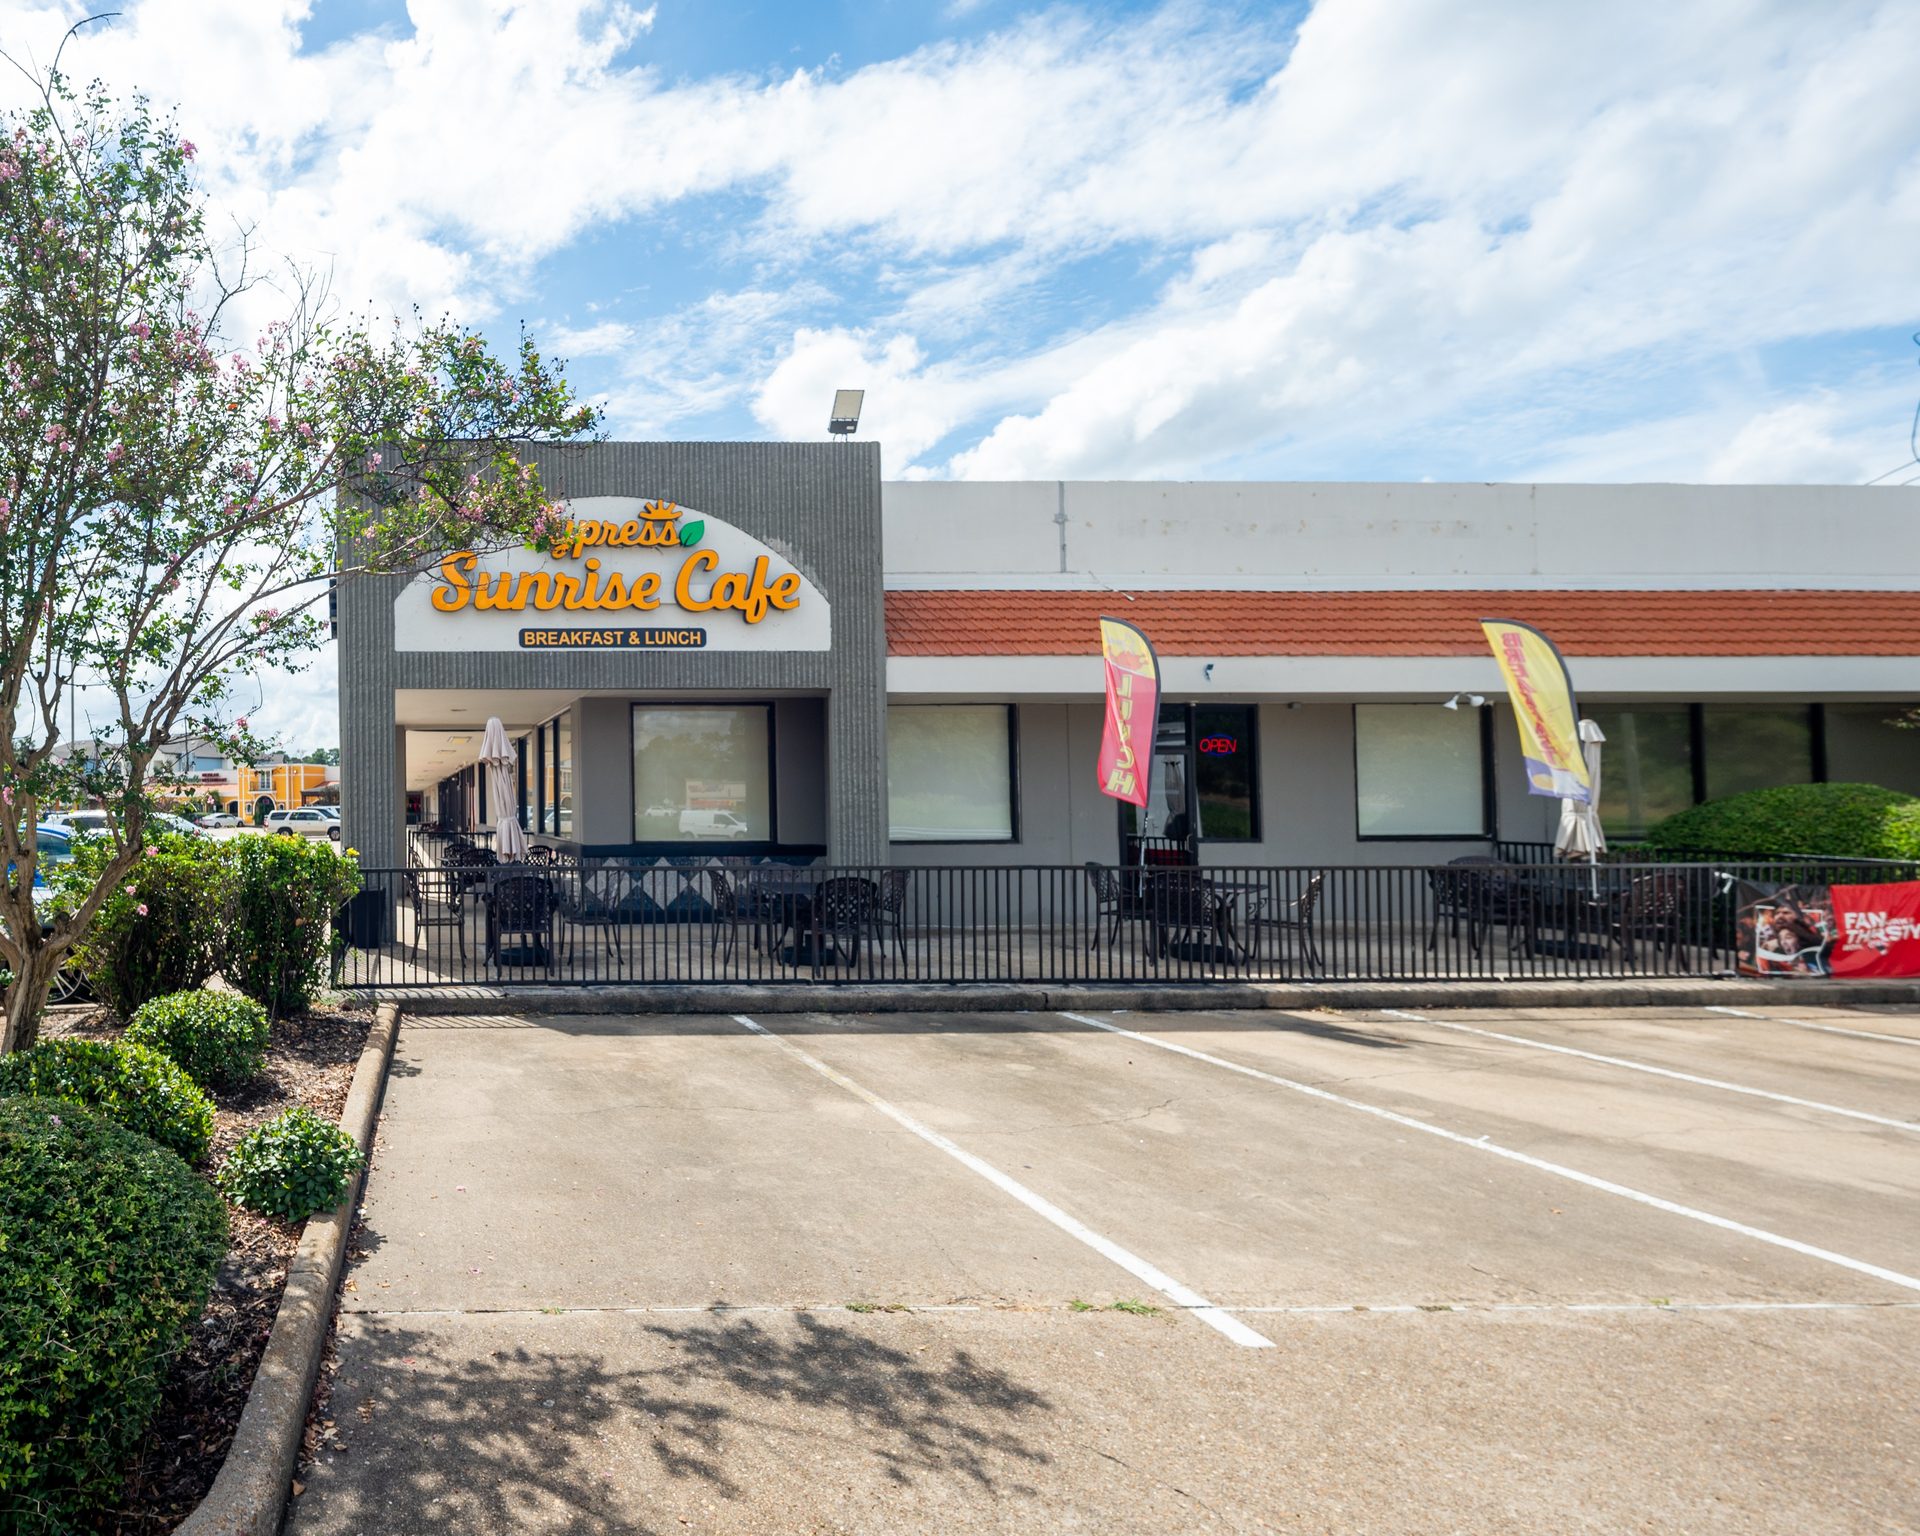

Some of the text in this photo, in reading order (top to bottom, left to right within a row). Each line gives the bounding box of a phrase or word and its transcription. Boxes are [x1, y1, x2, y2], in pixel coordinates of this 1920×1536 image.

[551, 518, 682, 560] ypress
[431, 549, 800, 624] Sunrise Cafe
[524, 631, 702, 646] BREAKFAST & LUNCH
[1199, 738, 1237, 753] OPEN
[1844, 911, 1887, 928] FAN
[1846, 923, 1920, 945] THRSTY
